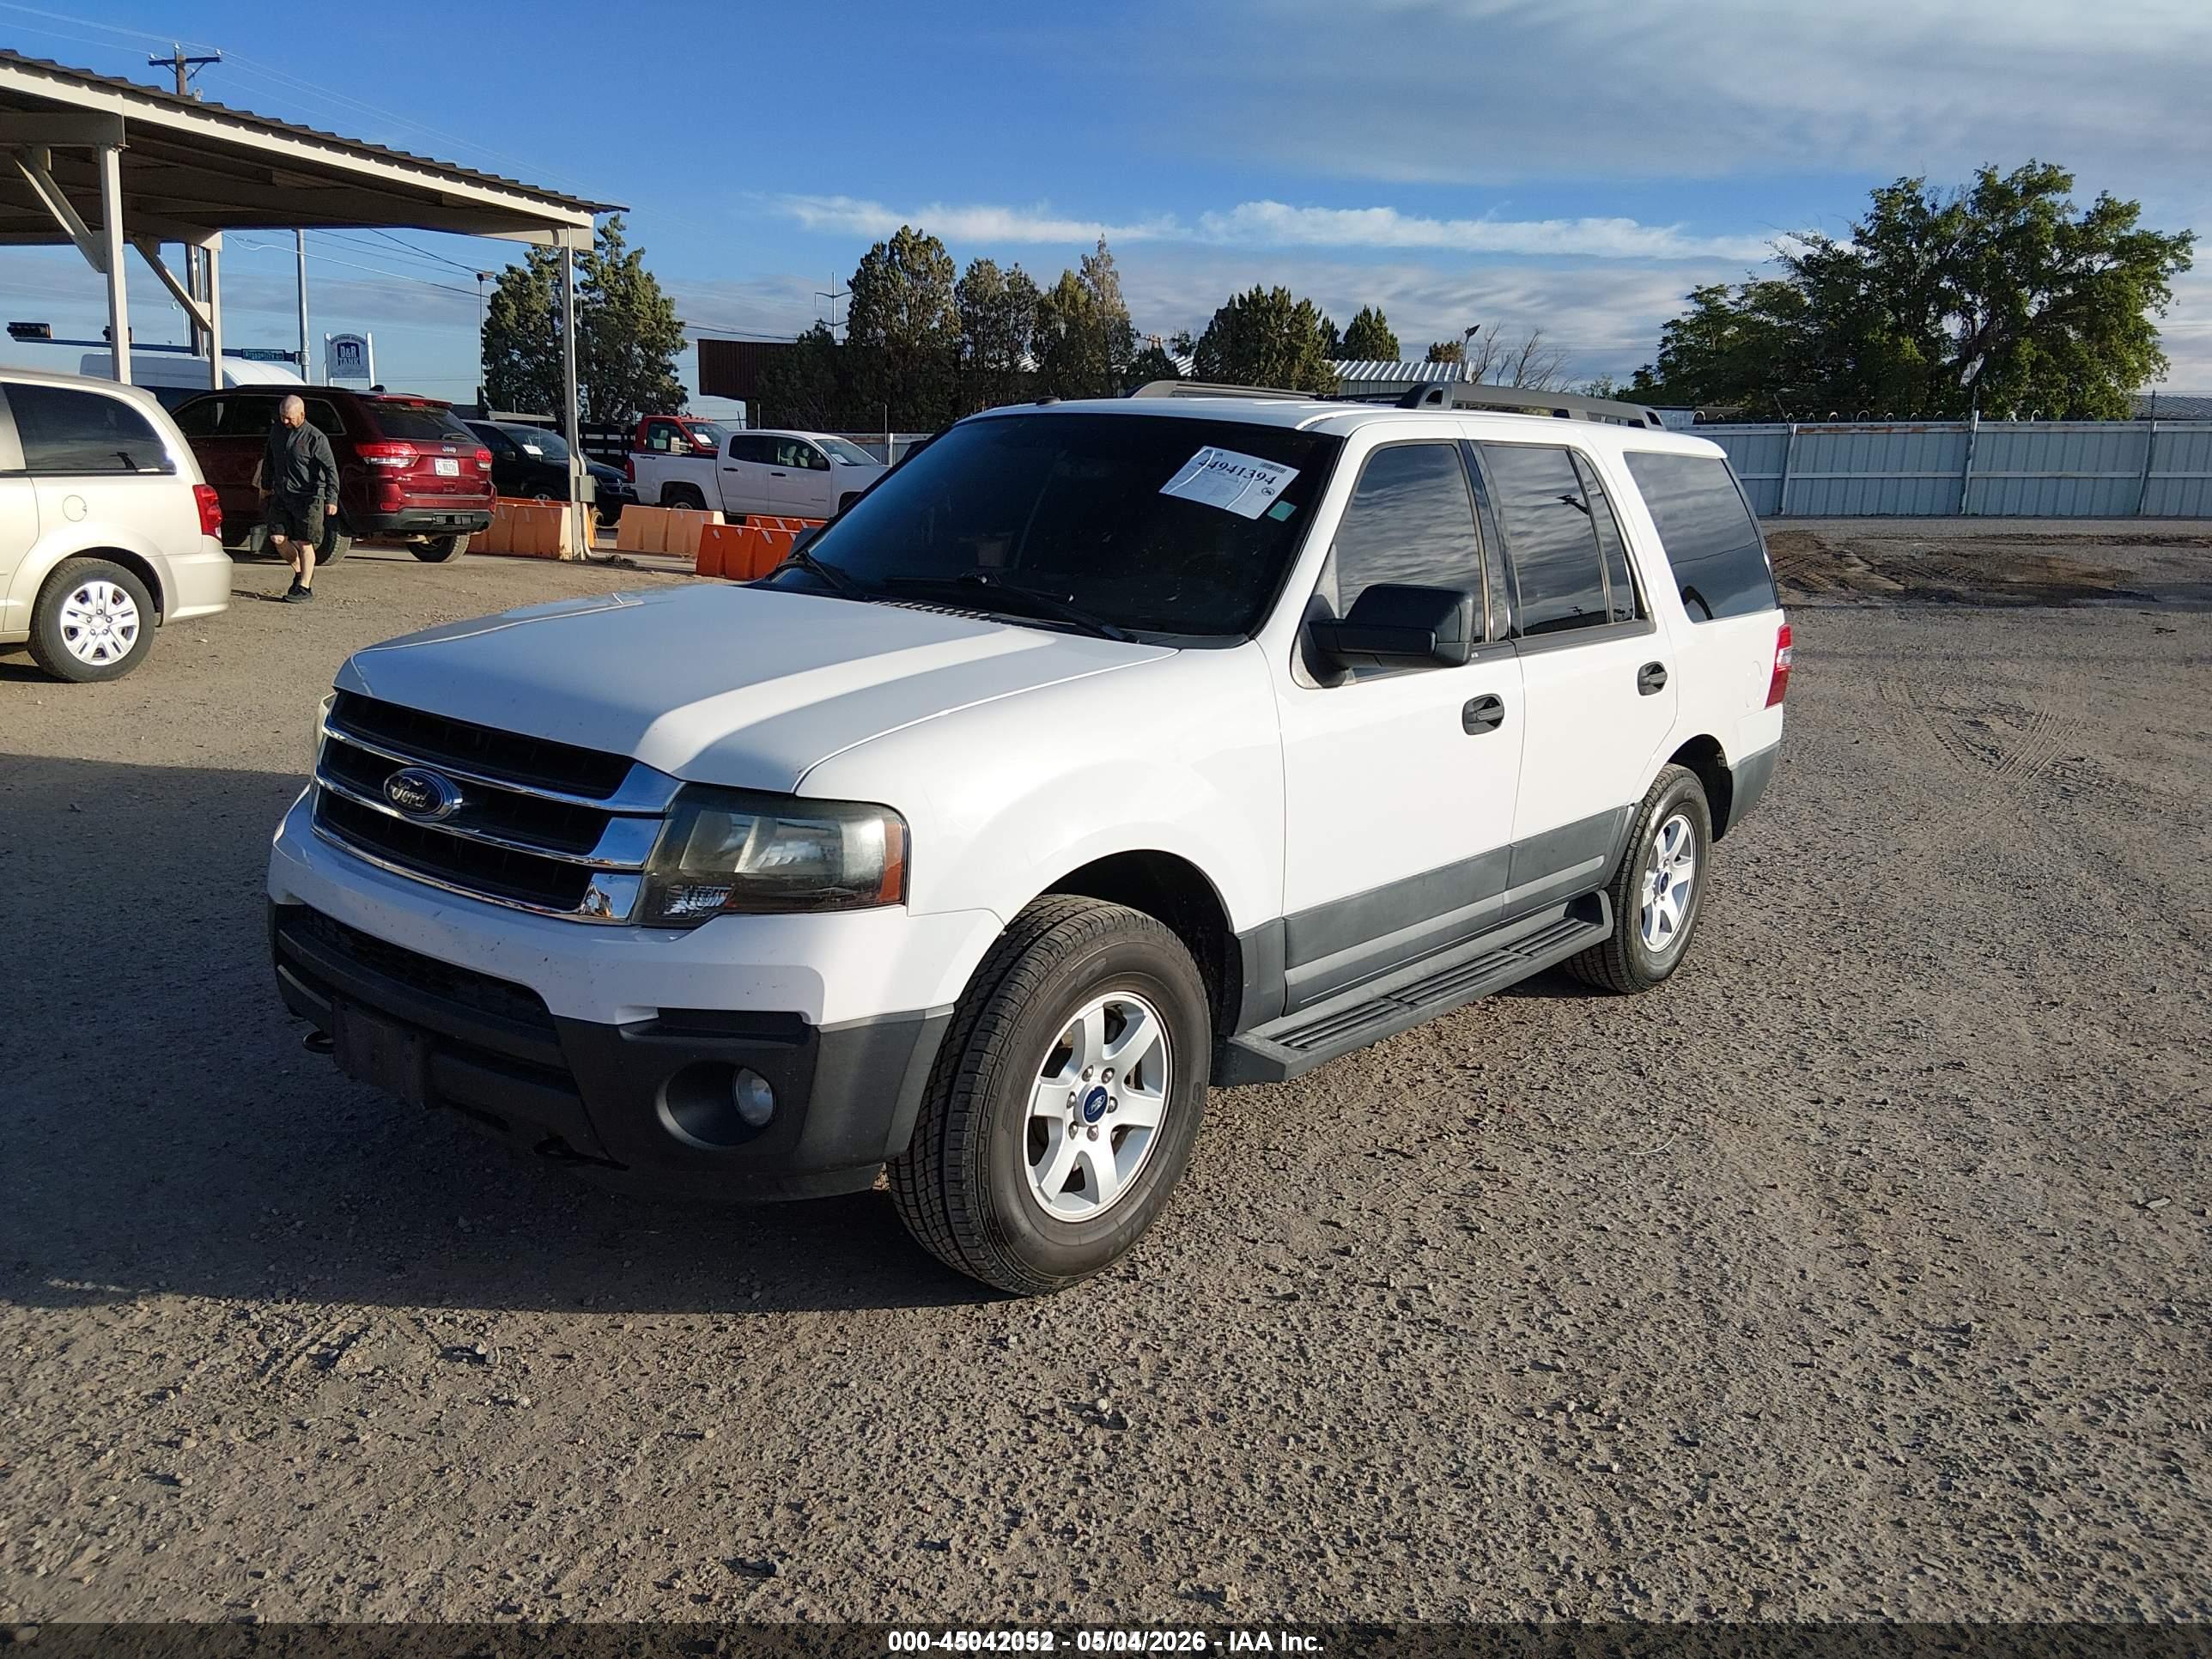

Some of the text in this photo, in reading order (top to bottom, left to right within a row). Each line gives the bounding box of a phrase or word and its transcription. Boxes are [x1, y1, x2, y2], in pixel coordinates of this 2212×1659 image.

[341, 346, 356, 357] D&R
[339, 357, 358, 366] TANK
[442, 445, 457, 453] Jeep
[1198, 459, 1277, 485] 44941394
[390, 775, 429, 807] Ford
